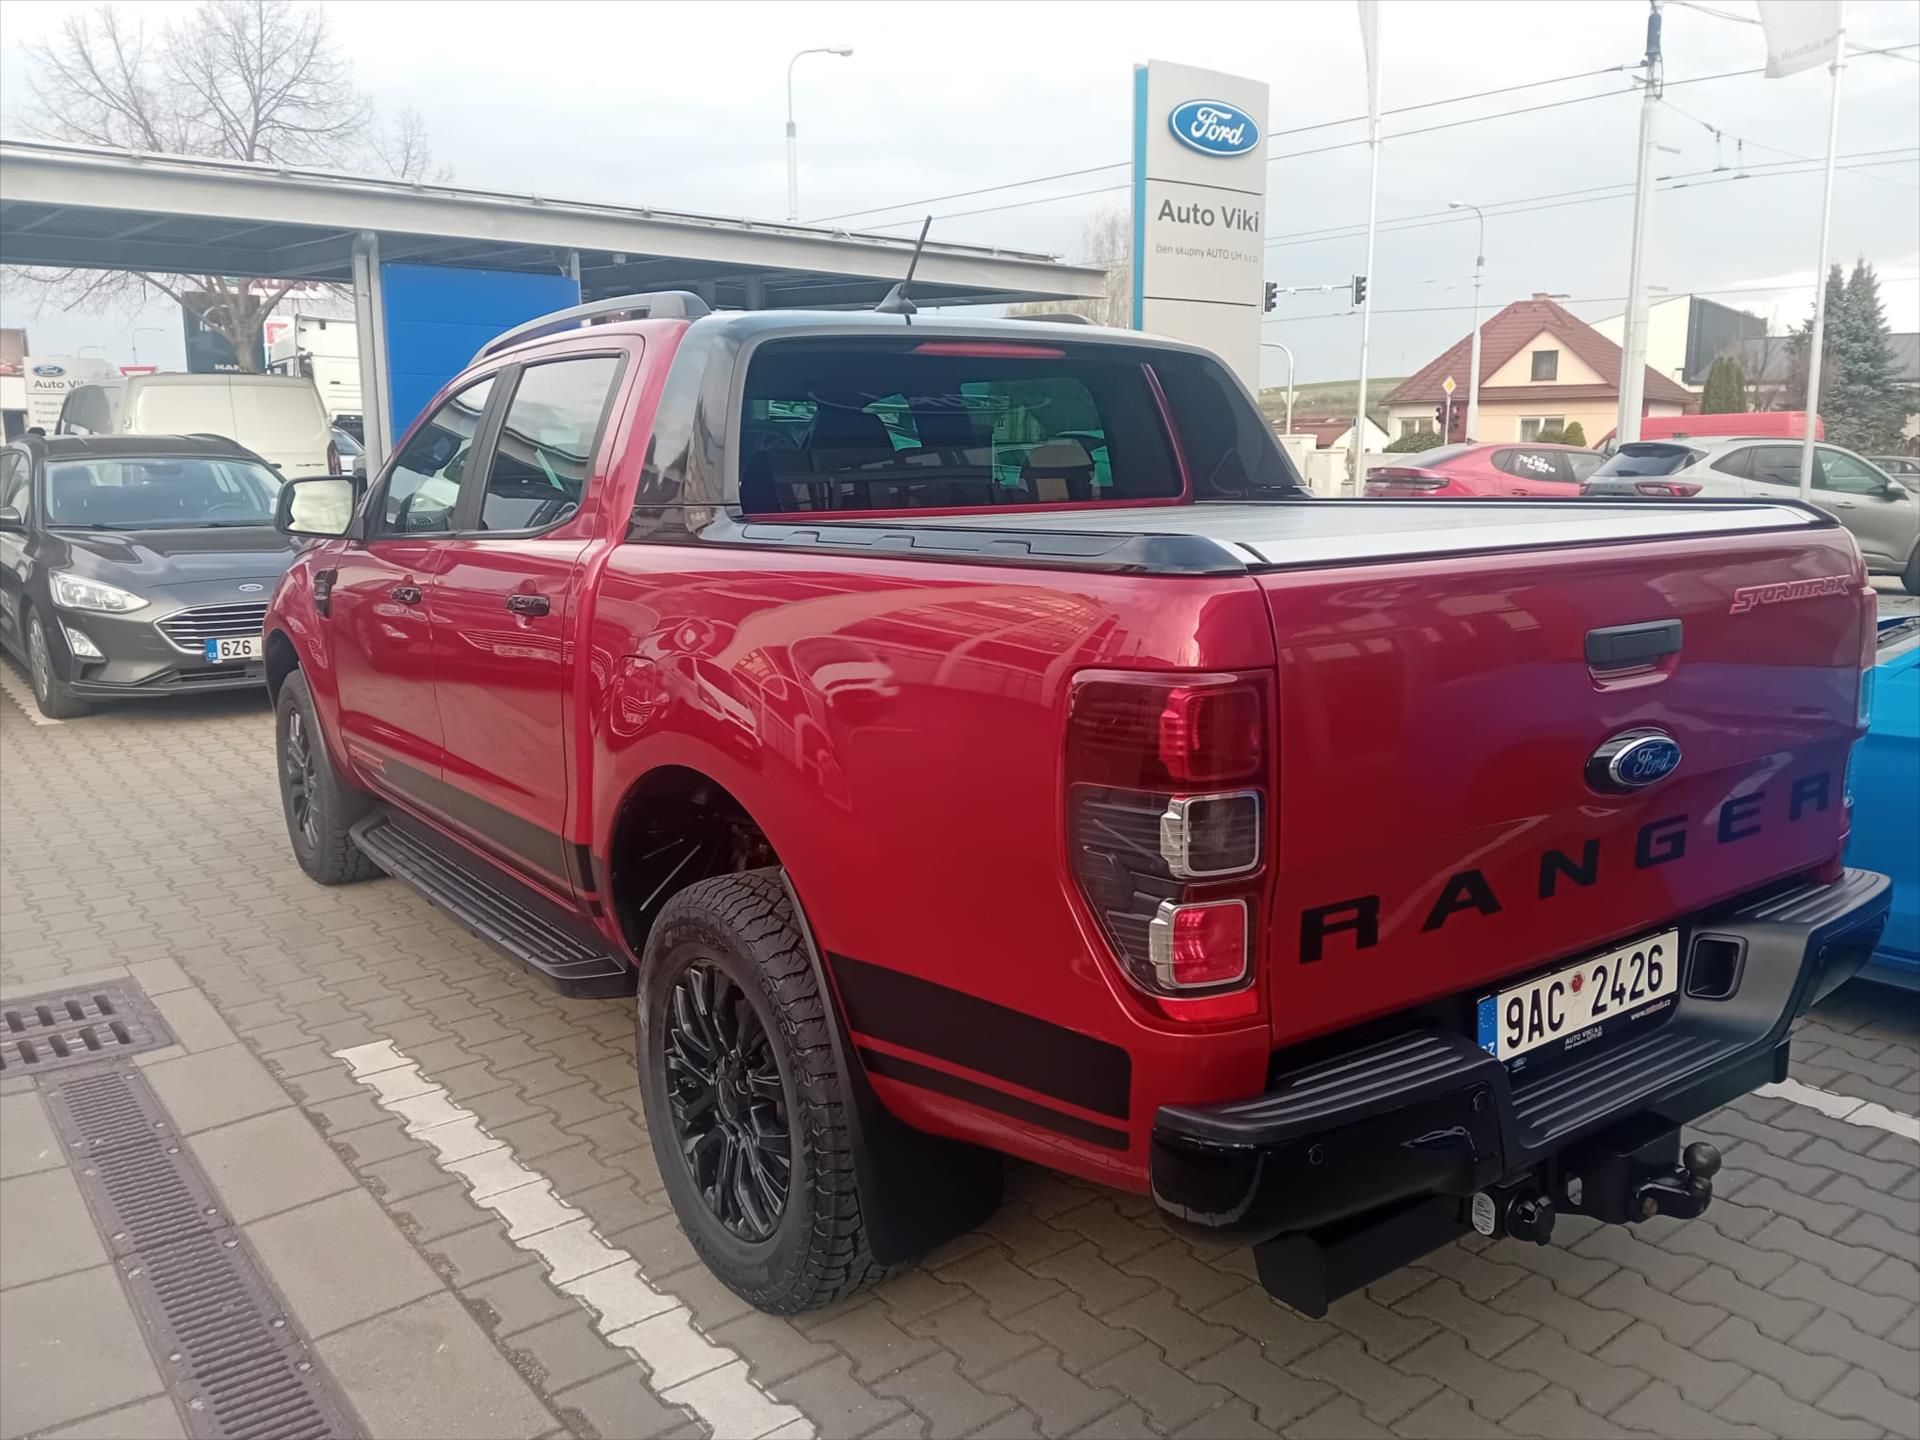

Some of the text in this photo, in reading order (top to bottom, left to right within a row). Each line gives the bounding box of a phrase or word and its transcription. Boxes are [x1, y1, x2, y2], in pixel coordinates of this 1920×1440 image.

[1190, 107, 1246, 146] Ford
[1158, 199, 1259, 233] Auto Viki
[1206, 248, 1230, 260] AUTO
[1231, 251, 1242, 261] UH
[34, 379, 65, 389] Auto
[1729, 574, 1851, 615] STORMTRAK
[221, 640, 252, 657] 6Z6
[1632, 746, 1673, 778] Ford
[1299, 770, 1832, 965] RANGER
[1506, 981, 1565, 1049] 9AC
[1591, 944, 1664, 1017] 2426
[1565, 1033, 1581, 1045] AUTO
